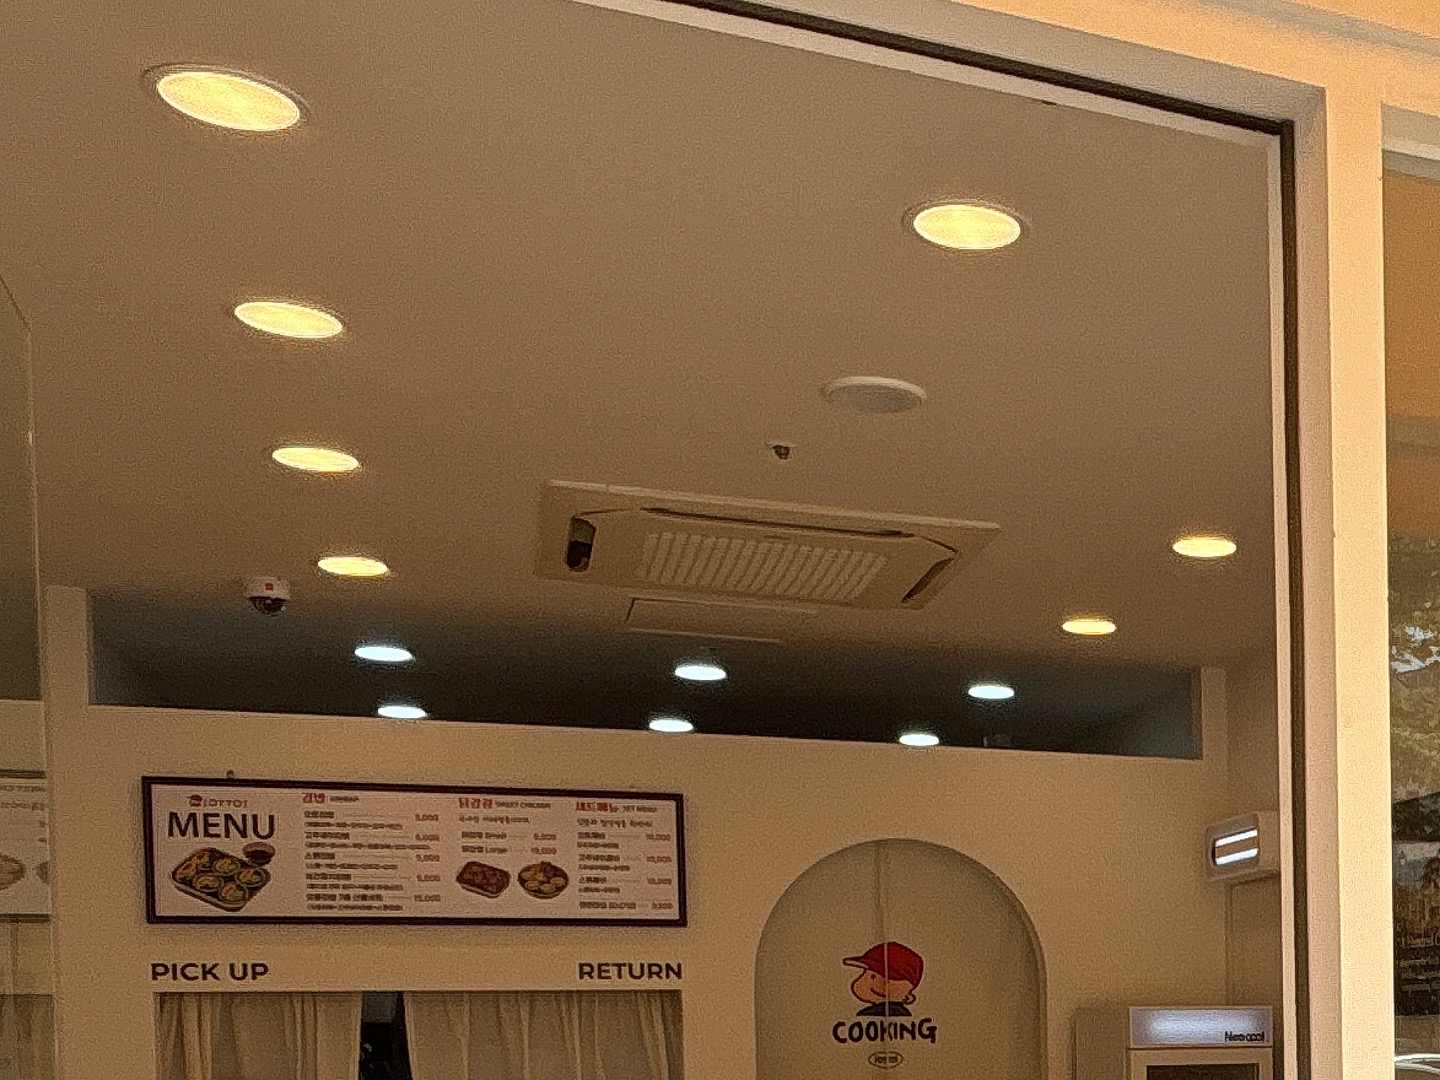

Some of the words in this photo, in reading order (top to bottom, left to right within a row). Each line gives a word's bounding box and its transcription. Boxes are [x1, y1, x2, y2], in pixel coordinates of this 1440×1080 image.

[167, 811, 275, 839] MENU
[151, 962, 220, 981] PICK
[229, 962, 269, 981] UP
[578, 962, 682, 980] RETURN
[832, 1017, 938, 1044] COOKING
